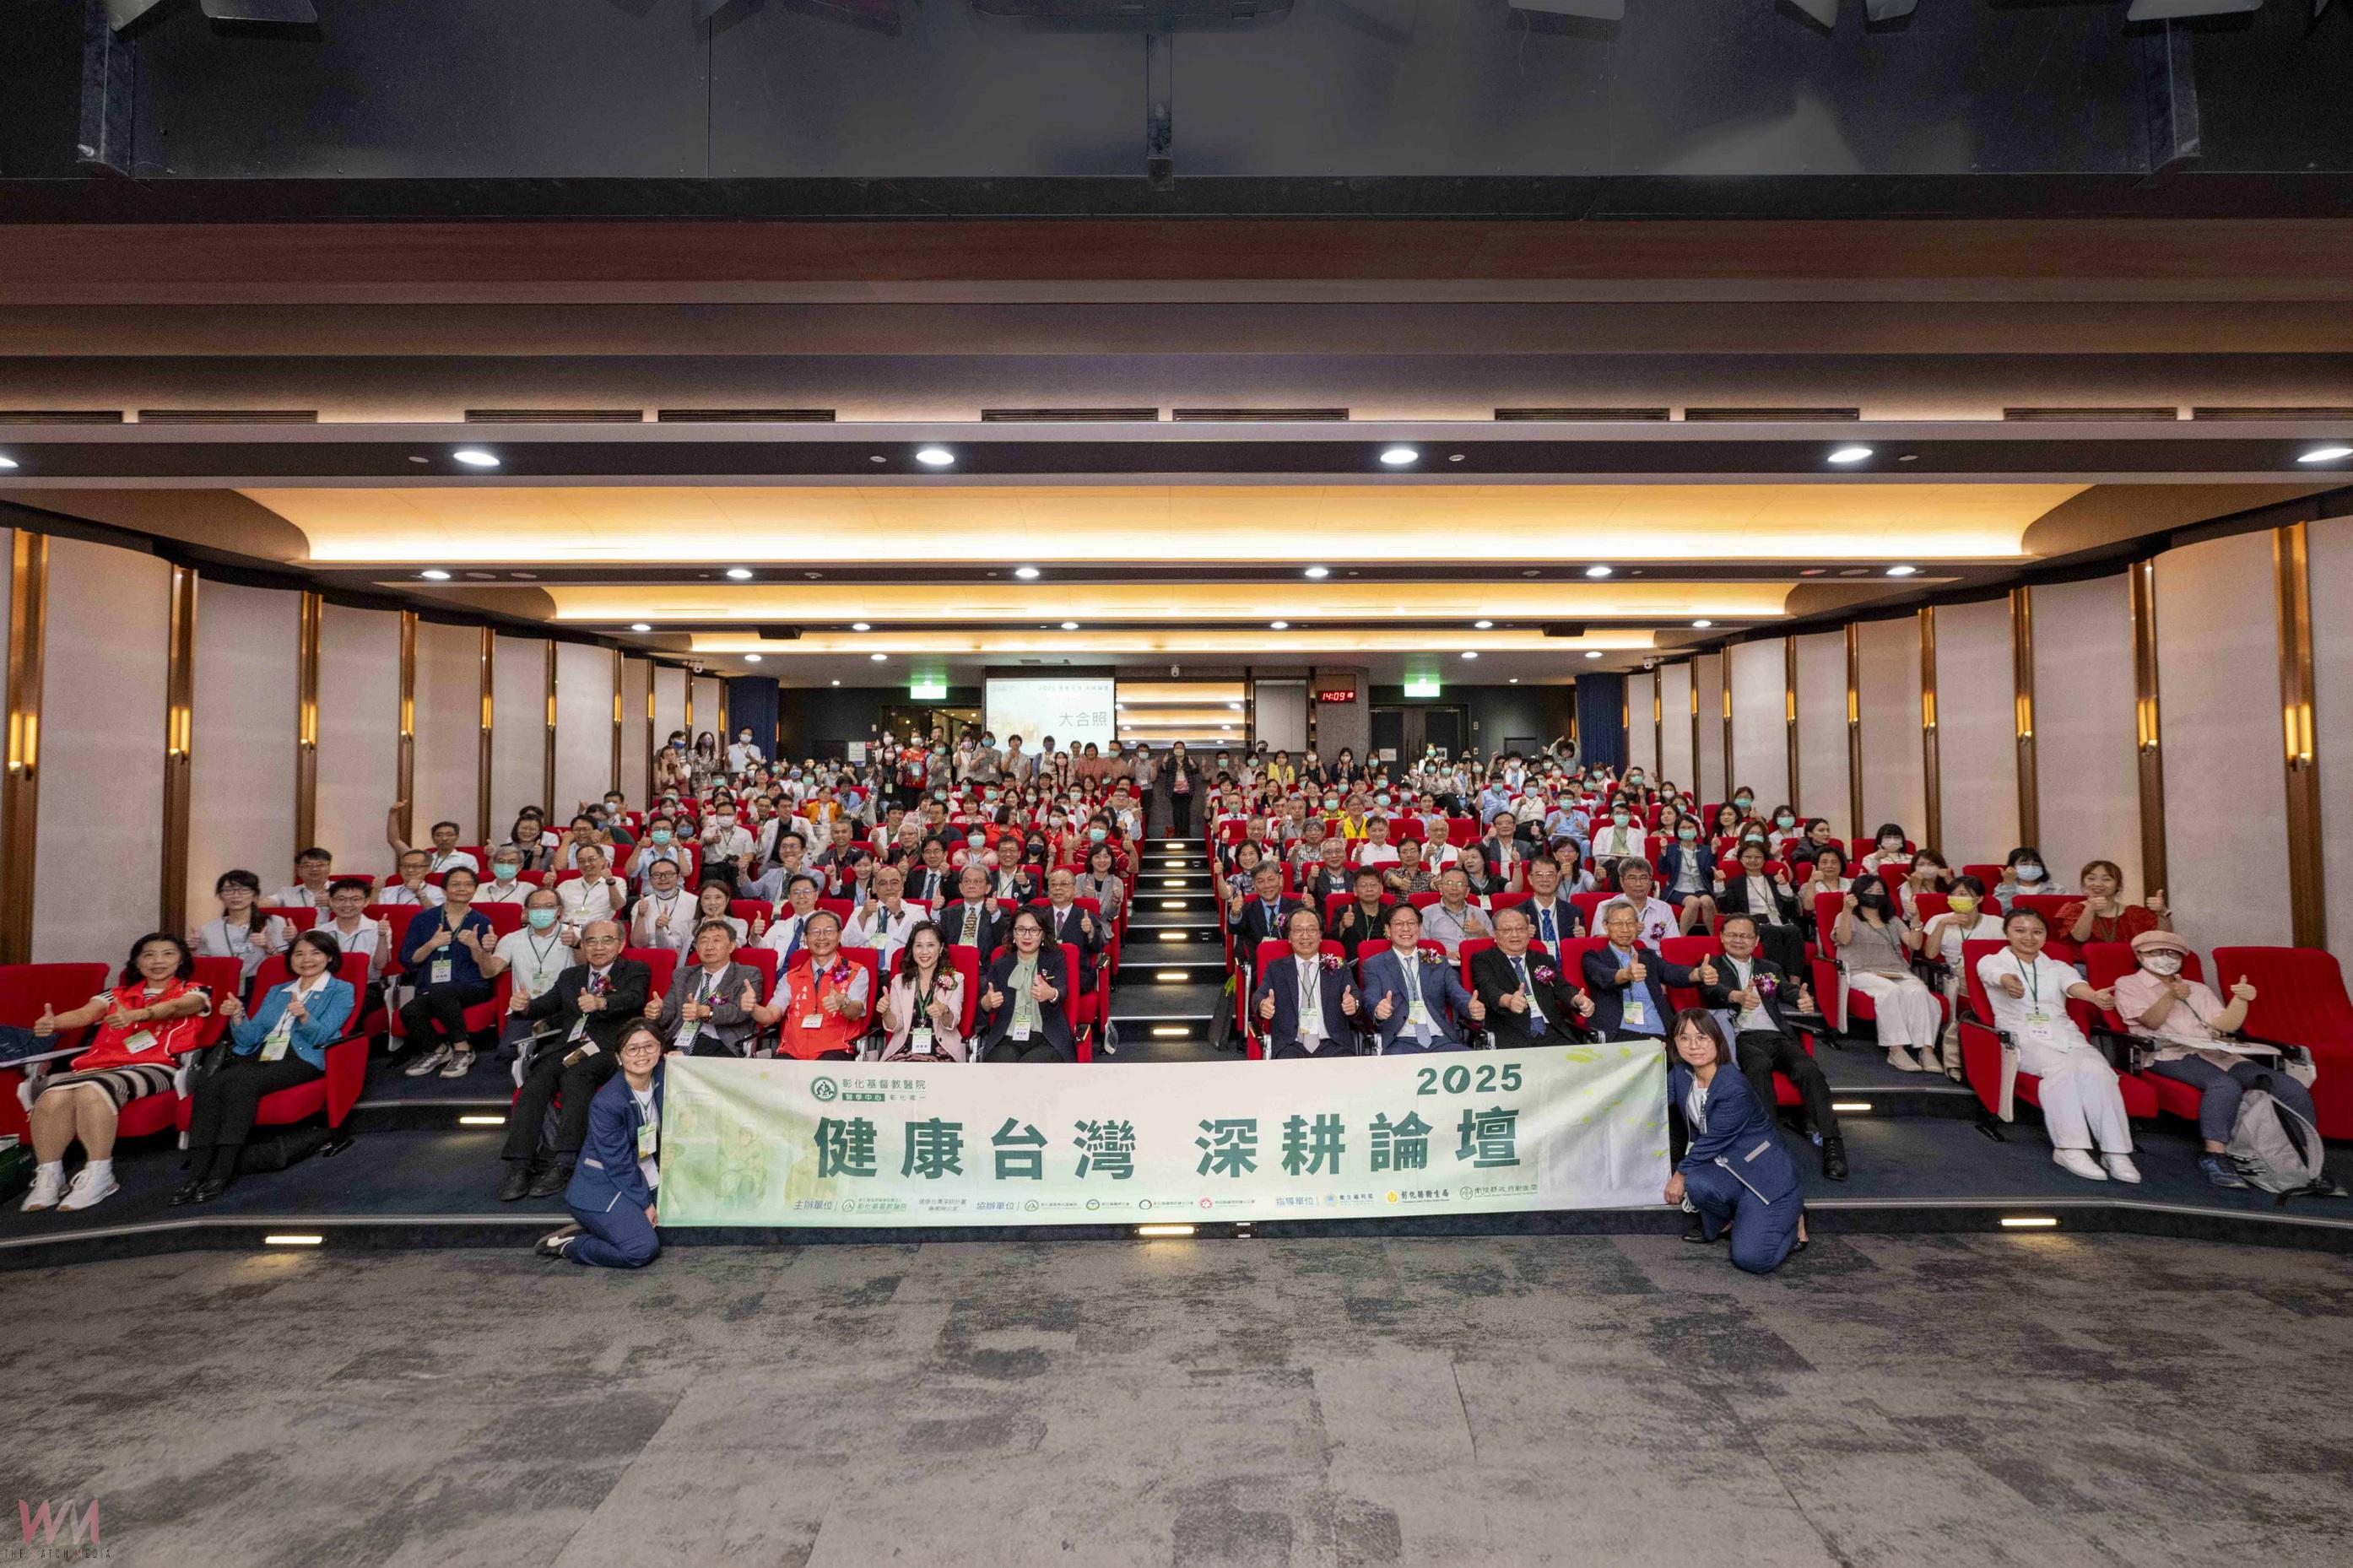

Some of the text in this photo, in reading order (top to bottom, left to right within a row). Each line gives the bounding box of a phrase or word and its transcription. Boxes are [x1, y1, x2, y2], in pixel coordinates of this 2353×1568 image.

[1323, 692, 1345, 700] 14:09
[1058, 711, 1107, 727] 大合照
[842, 1079, 926, 1089] 彰化基督教醫院
[1416, 1063, 1523, 1096] 2025
[814, 1105, 1521, 1180] 健康台灣 深耕論壇
[793, 1200, 833, 1210] 主辦單位
[976, 1201, 1014, 1210] 協辦單位
[1275, 1196, 1314, 1206] 指導單位
